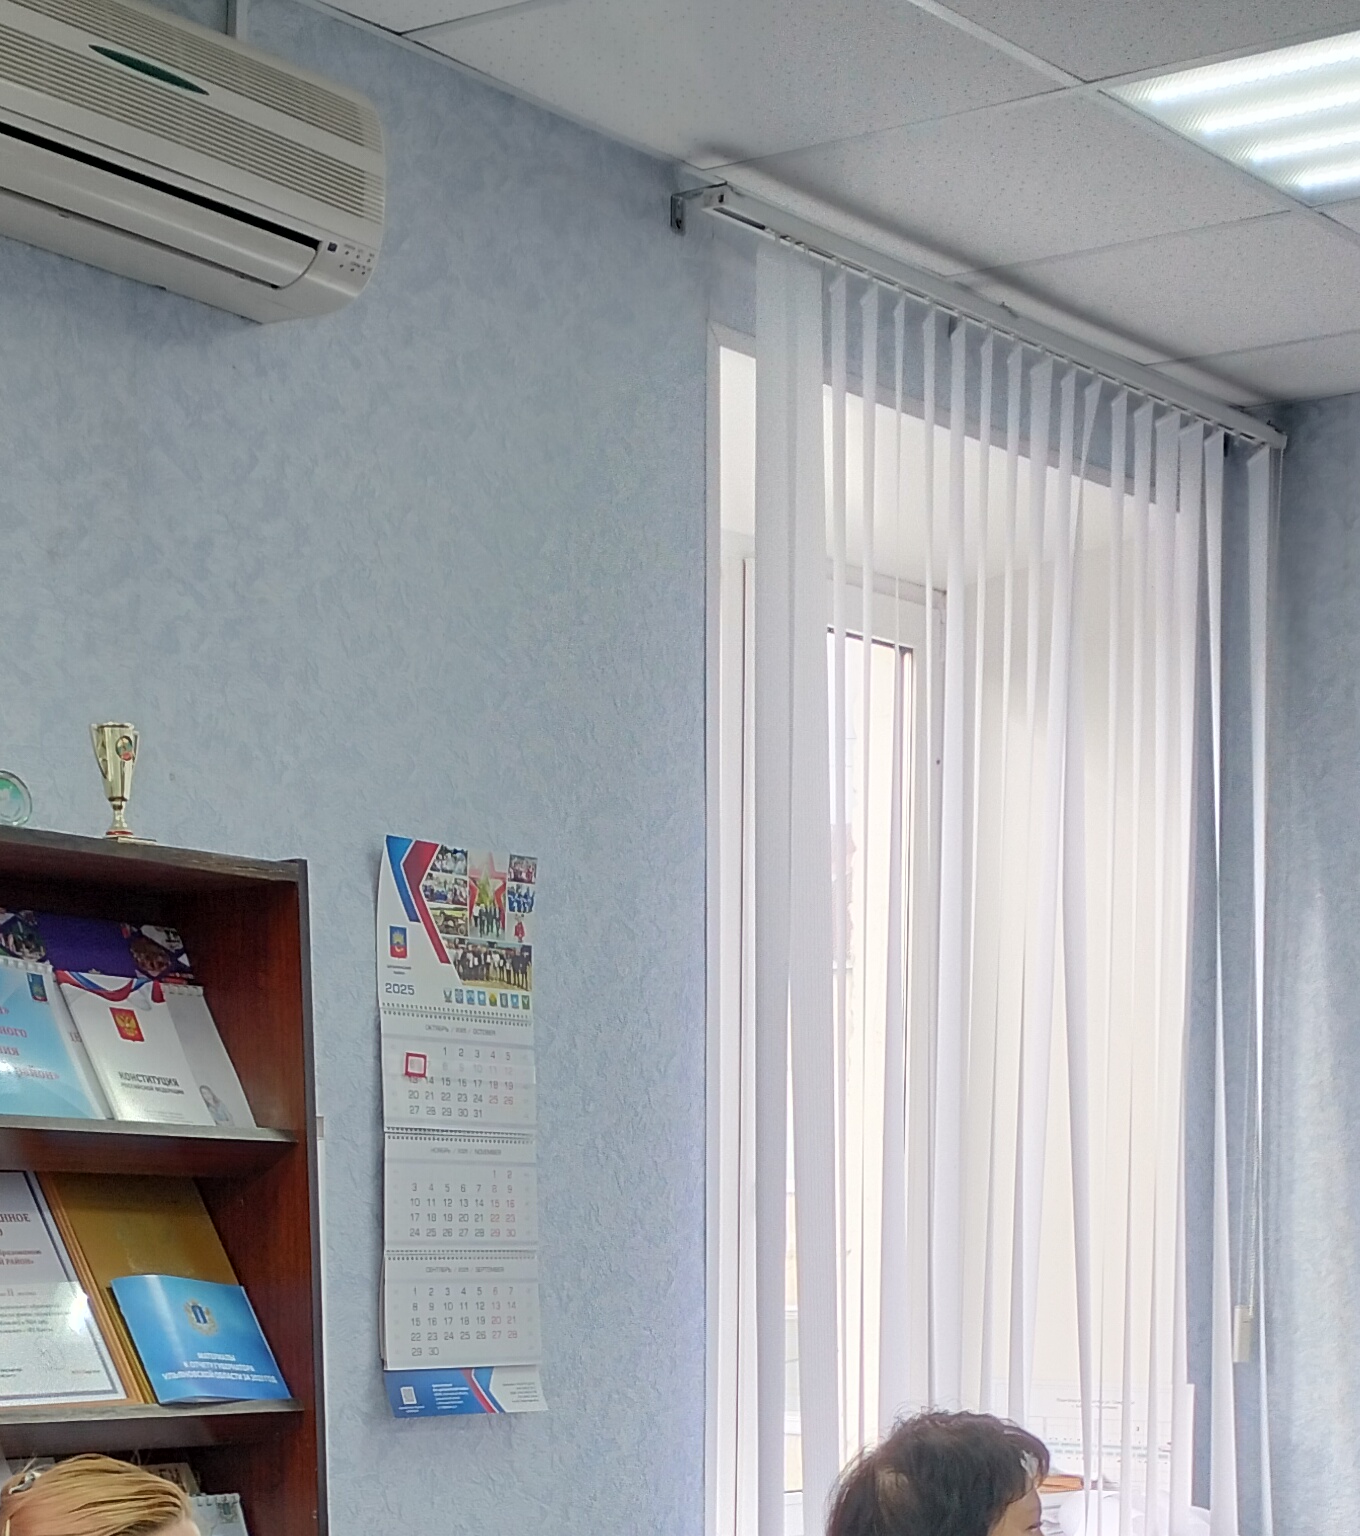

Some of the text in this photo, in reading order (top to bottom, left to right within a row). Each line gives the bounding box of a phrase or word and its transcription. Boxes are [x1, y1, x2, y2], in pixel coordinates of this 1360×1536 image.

[385, 982, 415, 996] 2025
[472, 1028, 496, 1036] OCTOBER
[458, 1048, 464, 1057] 2
[475, 1050, 480, 1058] 3
[490, 1051, 496, 1059] 4
[505, 1052, 511, 1061] 5
[119, 1071, 180, 1087] КОНСТИТУЦИЯ
[441, 1077, 451, 1086] 15
[457, 1078, 467, 1087] 16
[473, 1079, 482, 1088] 17
[489, 1080, 498, 1089] 18
[504, 1081, 513, 1090] 19
[408, 1090, 513, 1105] 20 21 22 23 24 25 26
[409, 1105, 482, 1118] 27 28 29 30 31
[507, 1170, 512, 1179] 2
[412, 1183, 512, 1193] 3 4 5 6 7 8 9
[410, 1198, 515, 1208] 10 11 12 13 14 15 16
[410, 1213, 515, 1223] 17 18 19 20 21 22 23
[409, 1228, 516, 1237] 24 25 26 27 28 29 30
[5, 1257, 34, 1266] РАЙОН»
[428, 1287, 434, 1296] 2
[445, 1287, 450, 1296] 3
[460, 1287, 466, 1295] 4
[477, 1287, 482, 1295] 5
[493, 1287, 498, 1295] 6
[508, 1287, 514, 1295] 7
[412, 1301, 516, 1311] 8 9 10 11 12 13 14
[411, 1316, 516, 1326] 15 16 17 18 19 20 21
[411, 1330, 518, 1341] 22 23 24 25 26 27 28
[411, 1347, 439, 1357] 29 30
